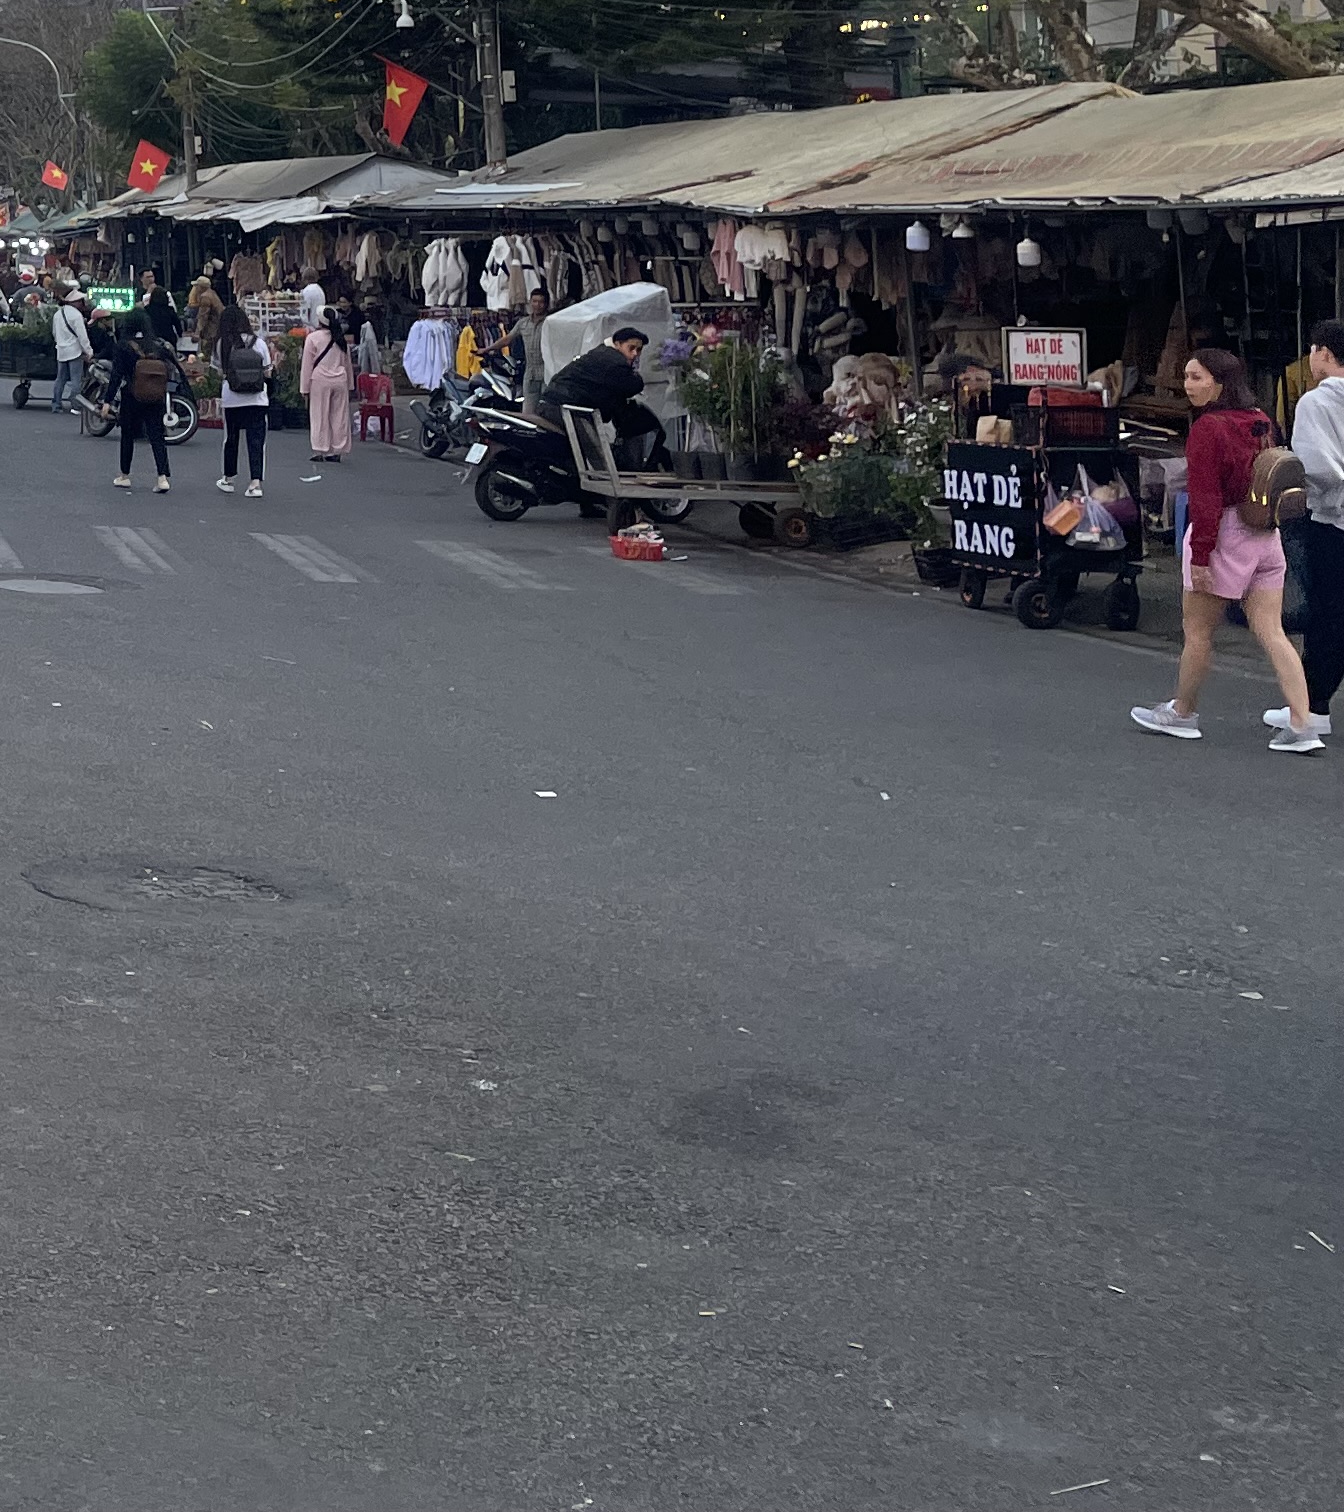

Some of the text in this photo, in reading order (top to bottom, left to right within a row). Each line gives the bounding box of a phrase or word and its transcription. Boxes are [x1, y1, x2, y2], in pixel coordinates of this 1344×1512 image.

[1014, 360, 1077, 380] RANG NÓNG
[943, 464, 1023, 510] HẠT DẺ
[954, 520, 1016, 559] RANG
